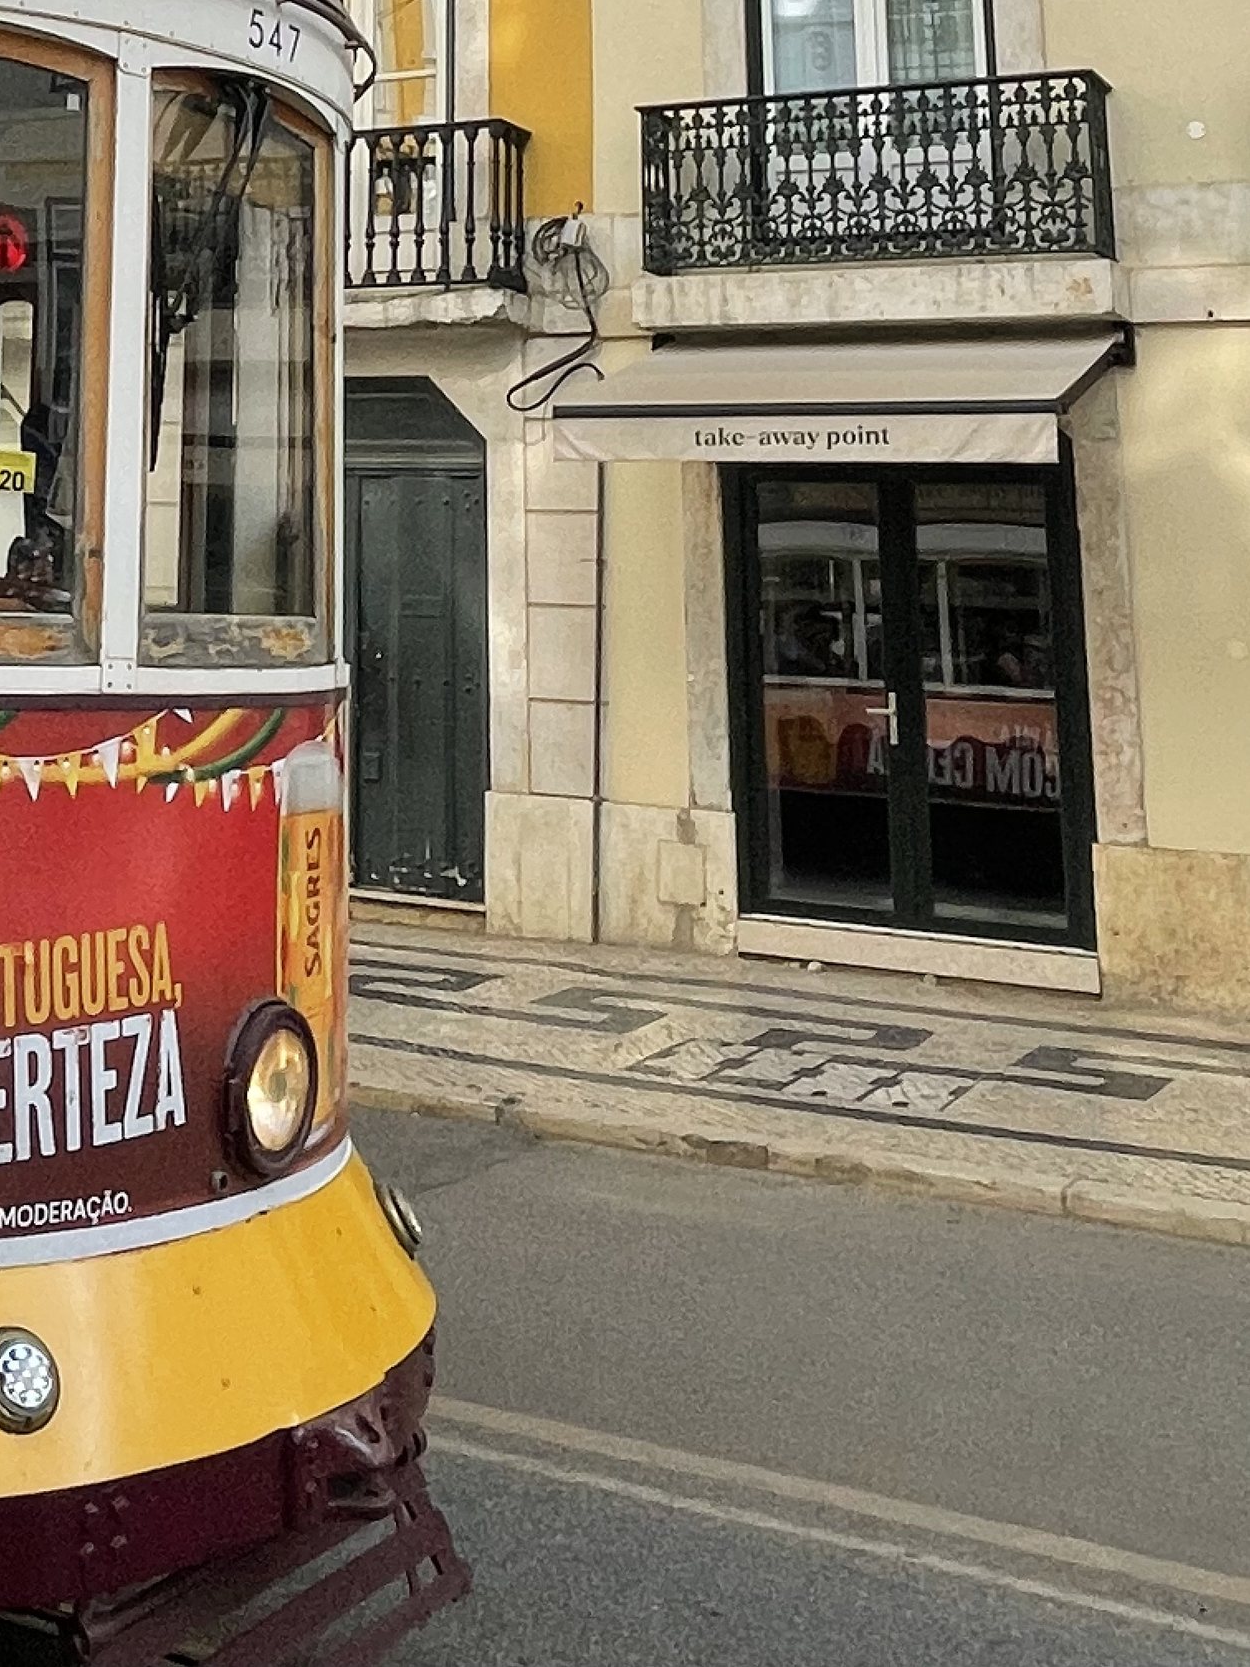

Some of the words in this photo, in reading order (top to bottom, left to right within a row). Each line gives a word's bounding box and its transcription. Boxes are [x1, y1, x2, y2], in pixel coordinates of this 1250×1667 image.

[248, 8, 301, 64] 547
[693, 426, 821, 451] take-away
[825, 424, 891, 451] point
[304, 825, 323, 979] SAGRES
